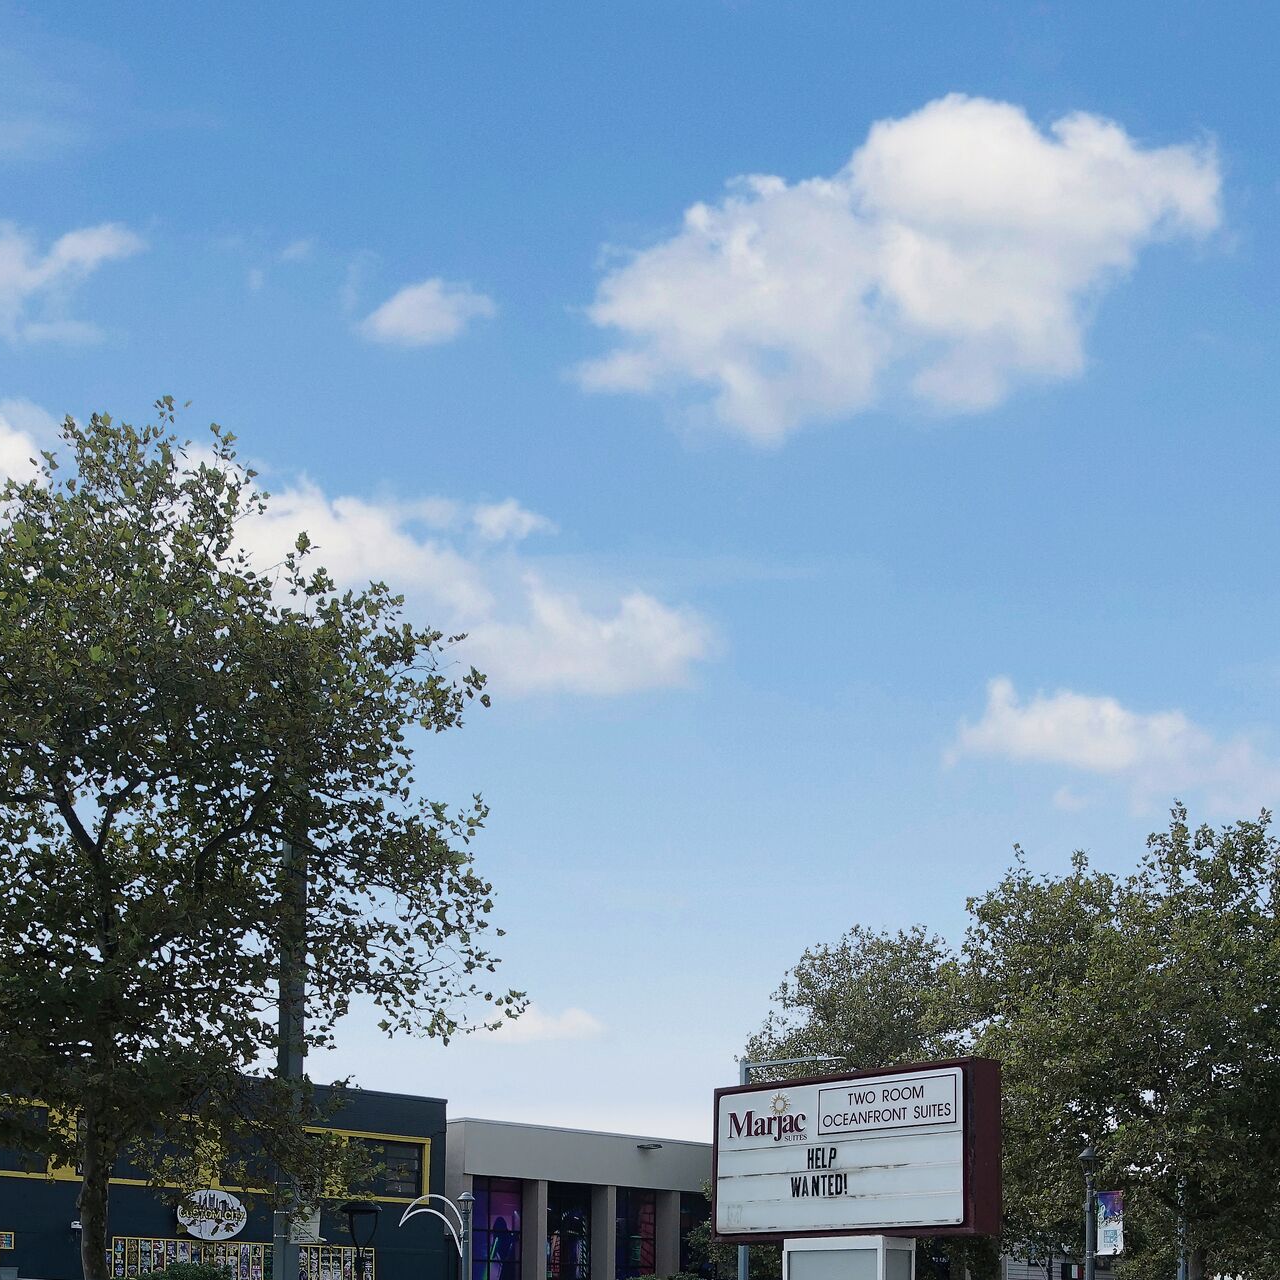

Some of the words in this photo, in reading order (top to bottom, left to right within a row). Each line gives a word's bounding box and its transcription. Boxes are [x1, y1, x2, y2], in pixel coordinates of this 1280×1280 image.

[848, 1091, 876, 1106] TWO
[882, 1085, 924, 1102] ROOM
[727, 1110, 807, 1142] Marjac
[822, 1107, 908, 1128] OCEANFRONT
[914, 1102, 952, 1119] SUITES
[784, 1133, 808, 1142] SUITES
[807, 1147, 837, 1169] HELP
[790, 1173, 848, 1198] WANTED!
